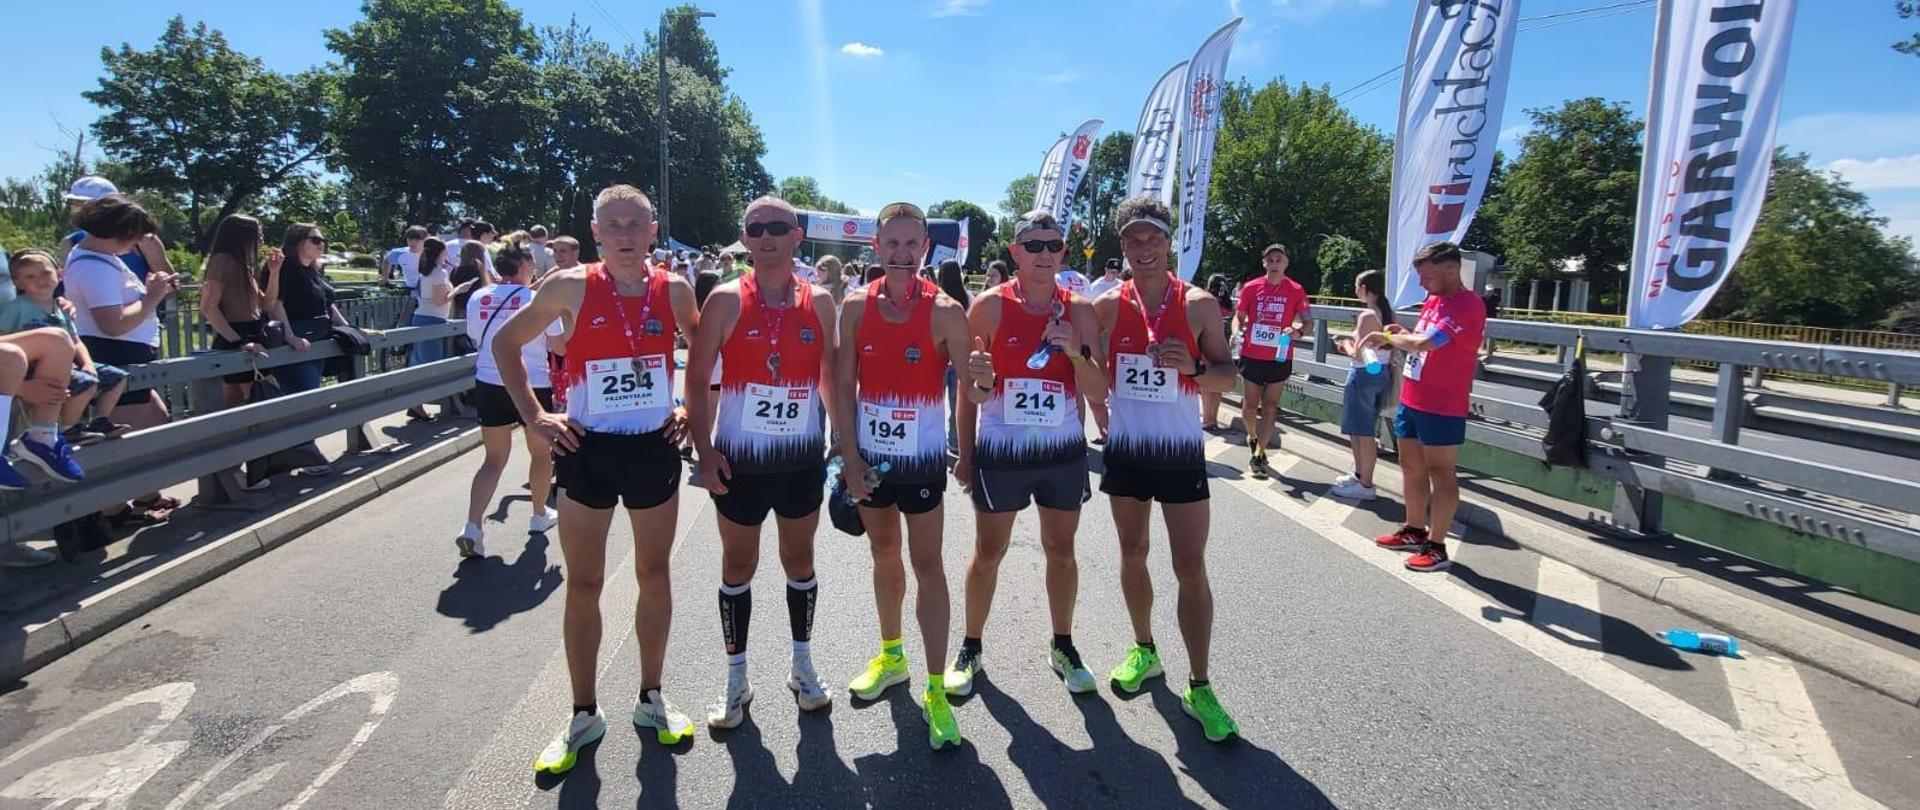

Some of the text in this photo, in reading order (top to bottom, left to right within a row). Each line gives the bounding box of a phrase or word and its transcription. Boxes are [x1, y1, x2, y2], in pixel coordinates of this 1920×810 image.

[1255, 329, 1275, 340] 500
[602, 372, 654, 395] 254
[1126, 368, 1166, 386] 213
[755, 400, 799, 419] 218
[1015, 392, 1055, 410] 214
[869, 419, 906, 439] 194
